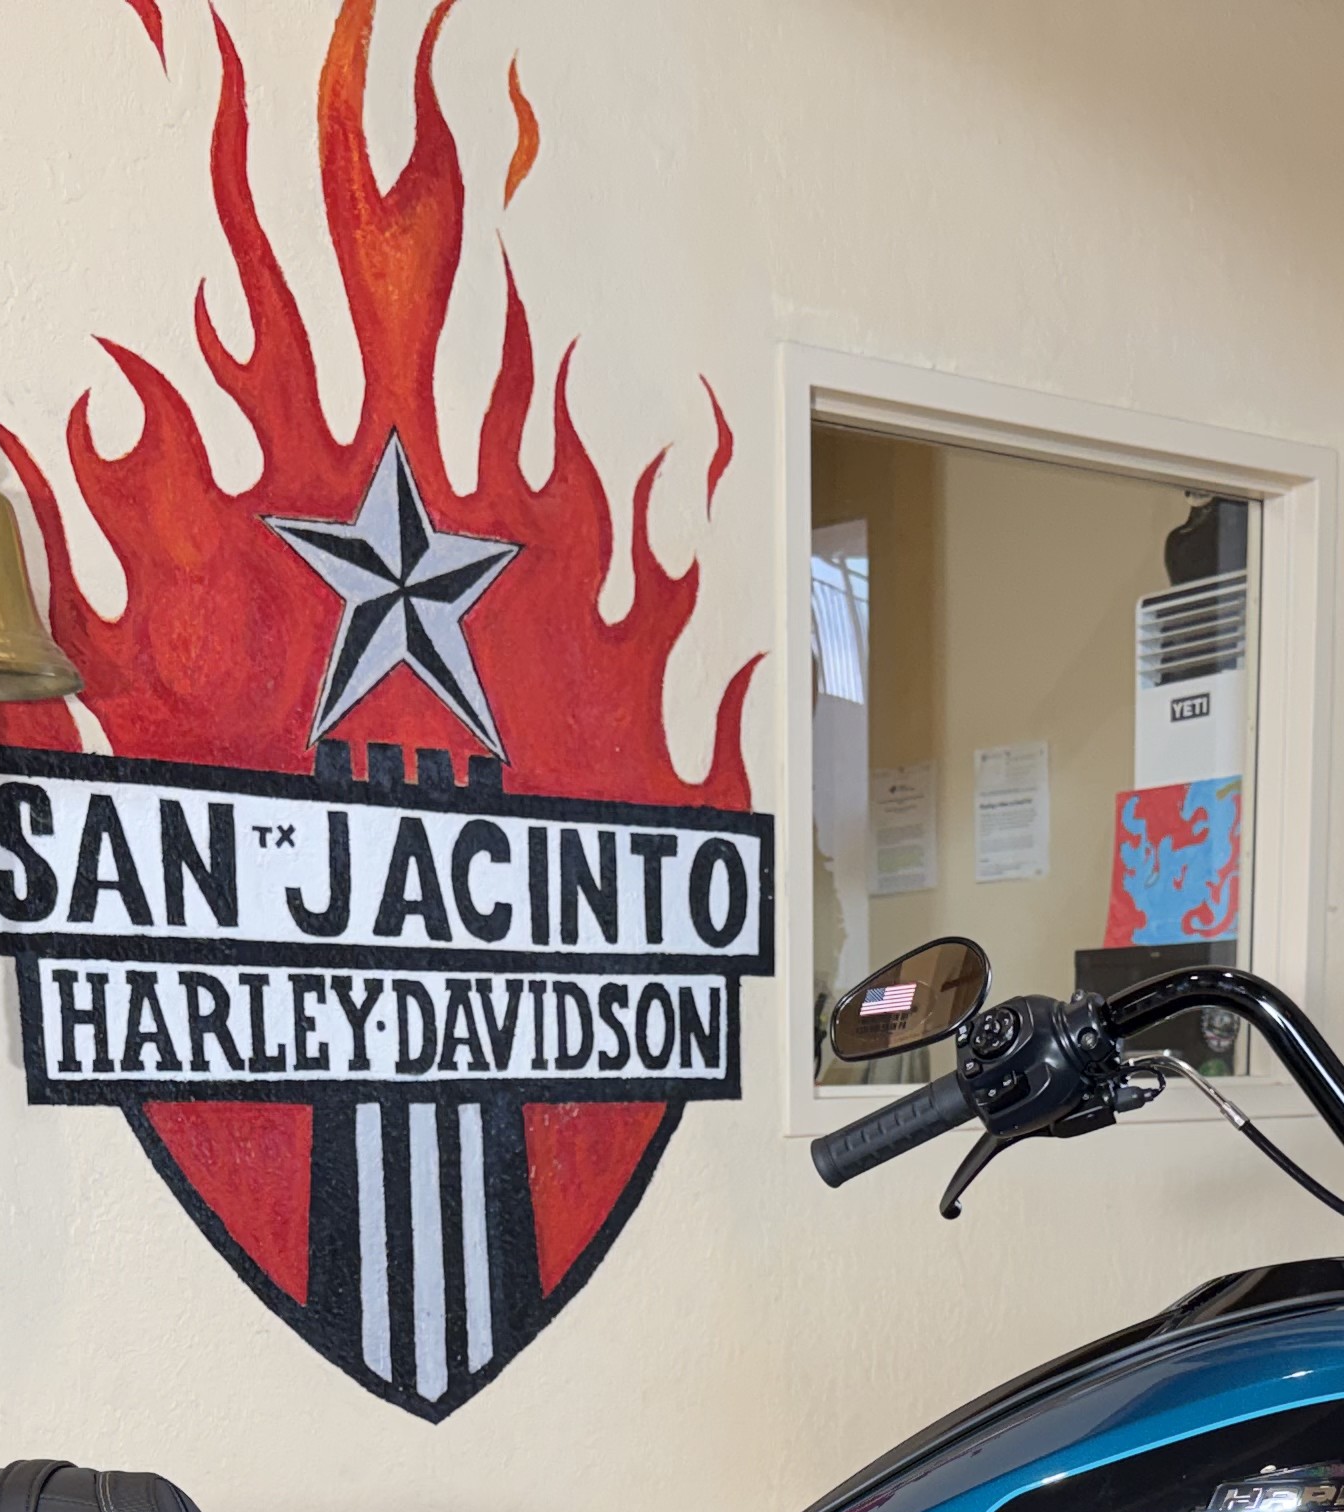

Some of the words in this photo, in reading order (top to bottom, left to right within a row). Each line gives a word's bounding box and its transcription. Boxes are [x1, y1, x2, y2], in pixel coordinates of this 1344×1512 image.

[1172, 698, 1208, 719] YETI
[251, 825, 296, 849] TX
[284, 811, 749, 949] JACINTO
